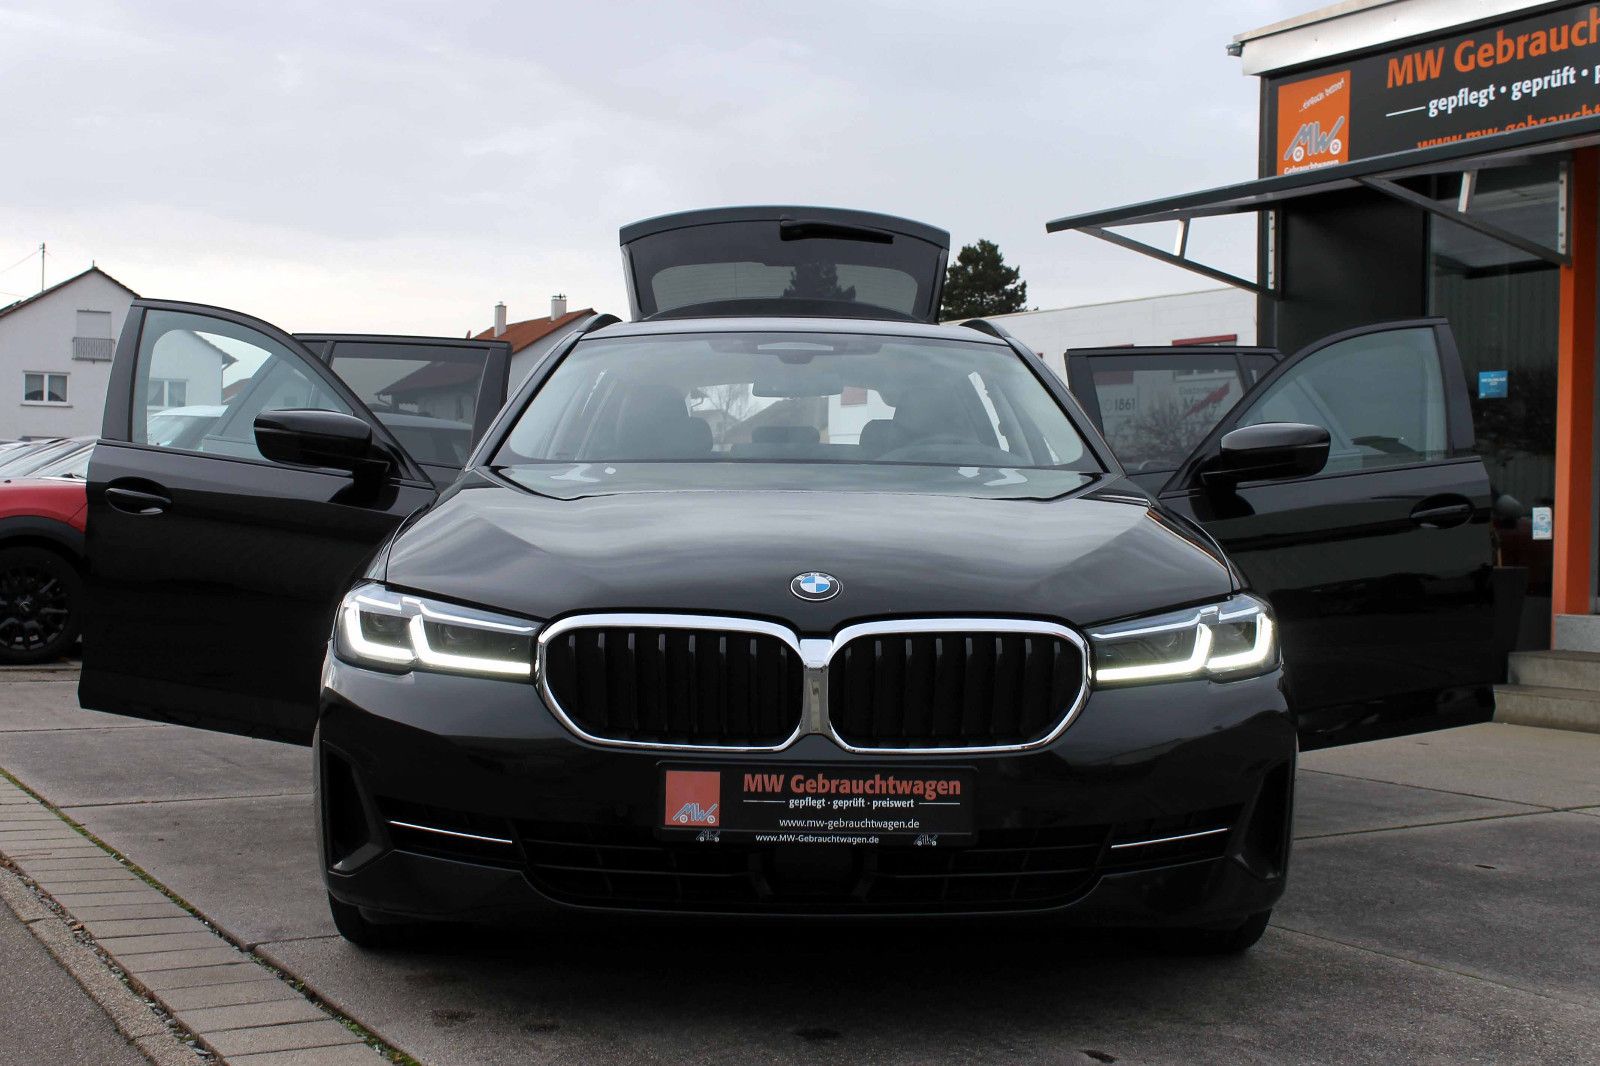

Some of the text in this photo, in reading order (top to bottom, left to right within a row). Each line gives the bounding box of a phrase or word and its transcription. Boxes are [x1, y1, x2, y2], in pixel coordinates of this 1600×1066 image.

[1386, 46, 1446, 89] MW
[1428, 83, 1496, 117] gepflegt
[1511, 65, 1576, 101] geprüft
[742, 773, 961, 800] MW Gebrauchtwagen
[788, 797, 915, 810] gepflegt geprüft preiswert
[779, 818, 920, 831] www.mw-gebrauchtwagen.de
[755, 834, 880, 846] www.MW-Gebrauchtwagen.de
